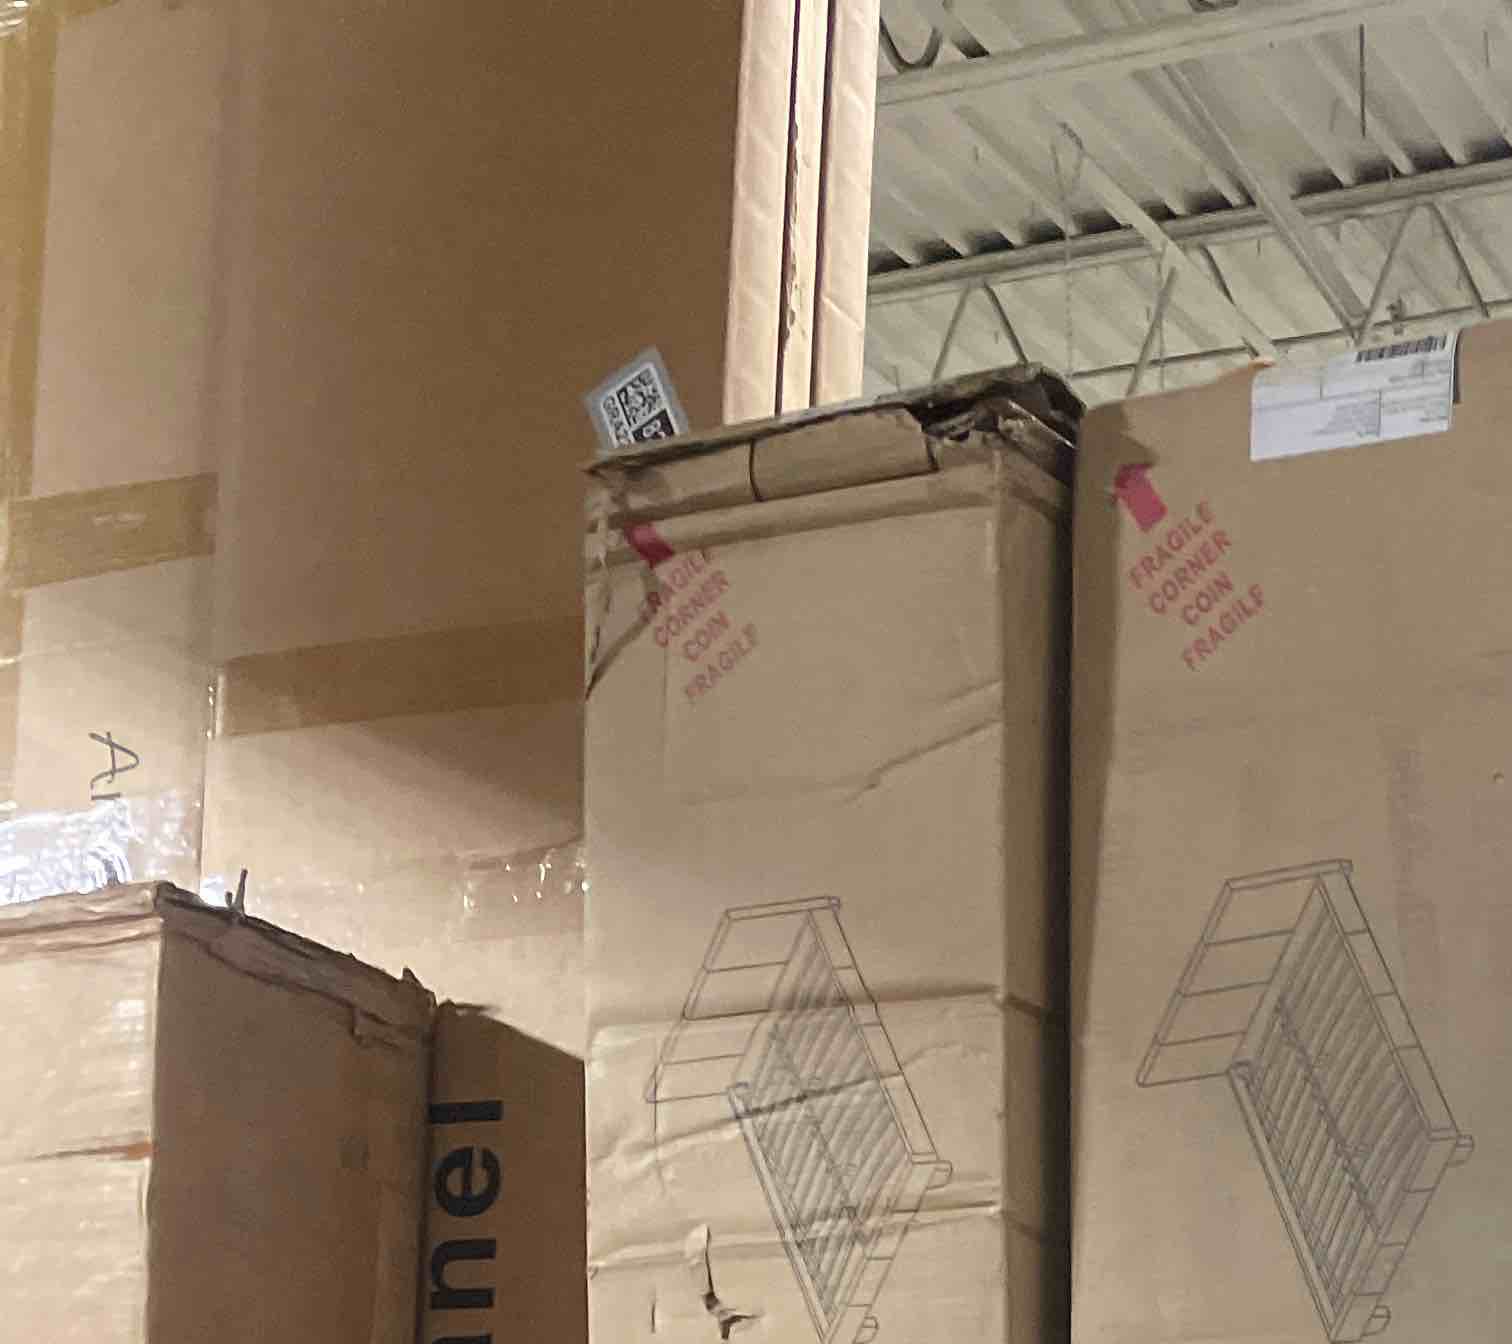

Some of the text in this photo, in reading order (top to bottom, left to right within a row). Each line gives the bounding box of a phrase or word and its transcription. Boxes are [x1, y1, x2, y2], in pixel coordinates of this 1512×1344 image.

[1131, 502, 1215, 590] FRAGILE
[1148, 531, 1232, 615] CORNER
[1179, 573, 1234, 627] COIN
[1183, 583, 1266, 673] FRAGILE
